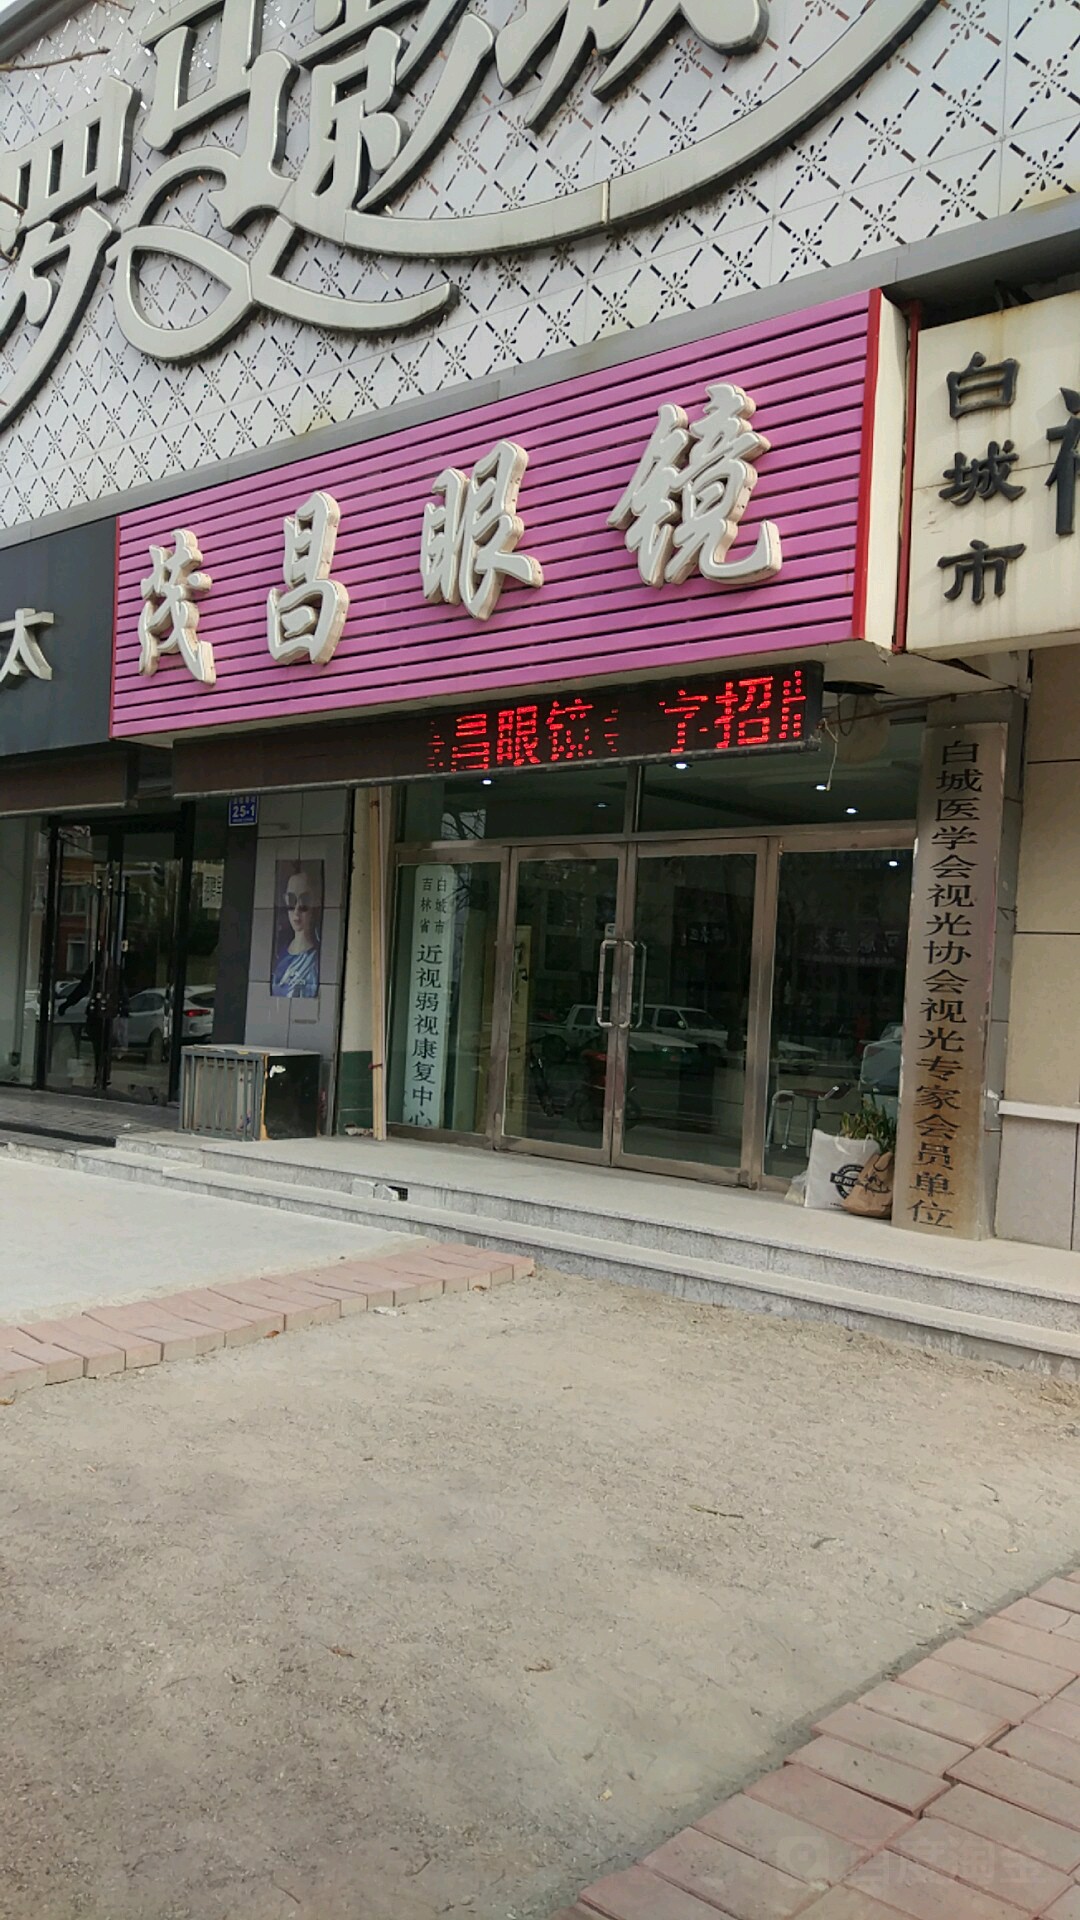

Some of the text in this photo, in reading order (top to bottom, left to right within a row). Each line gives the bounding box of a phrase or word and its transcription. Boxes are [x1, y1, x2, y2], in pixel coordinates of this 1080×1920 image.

[138, 383, 784, 686] 茂昌眼镜
[937, 351, 1027, 604] 白城市
[409, 944, 443, 1127] 近视弱视康复中心
[907, 740, 984, 1229] 白城医学会视光协会视光专家会员单位
